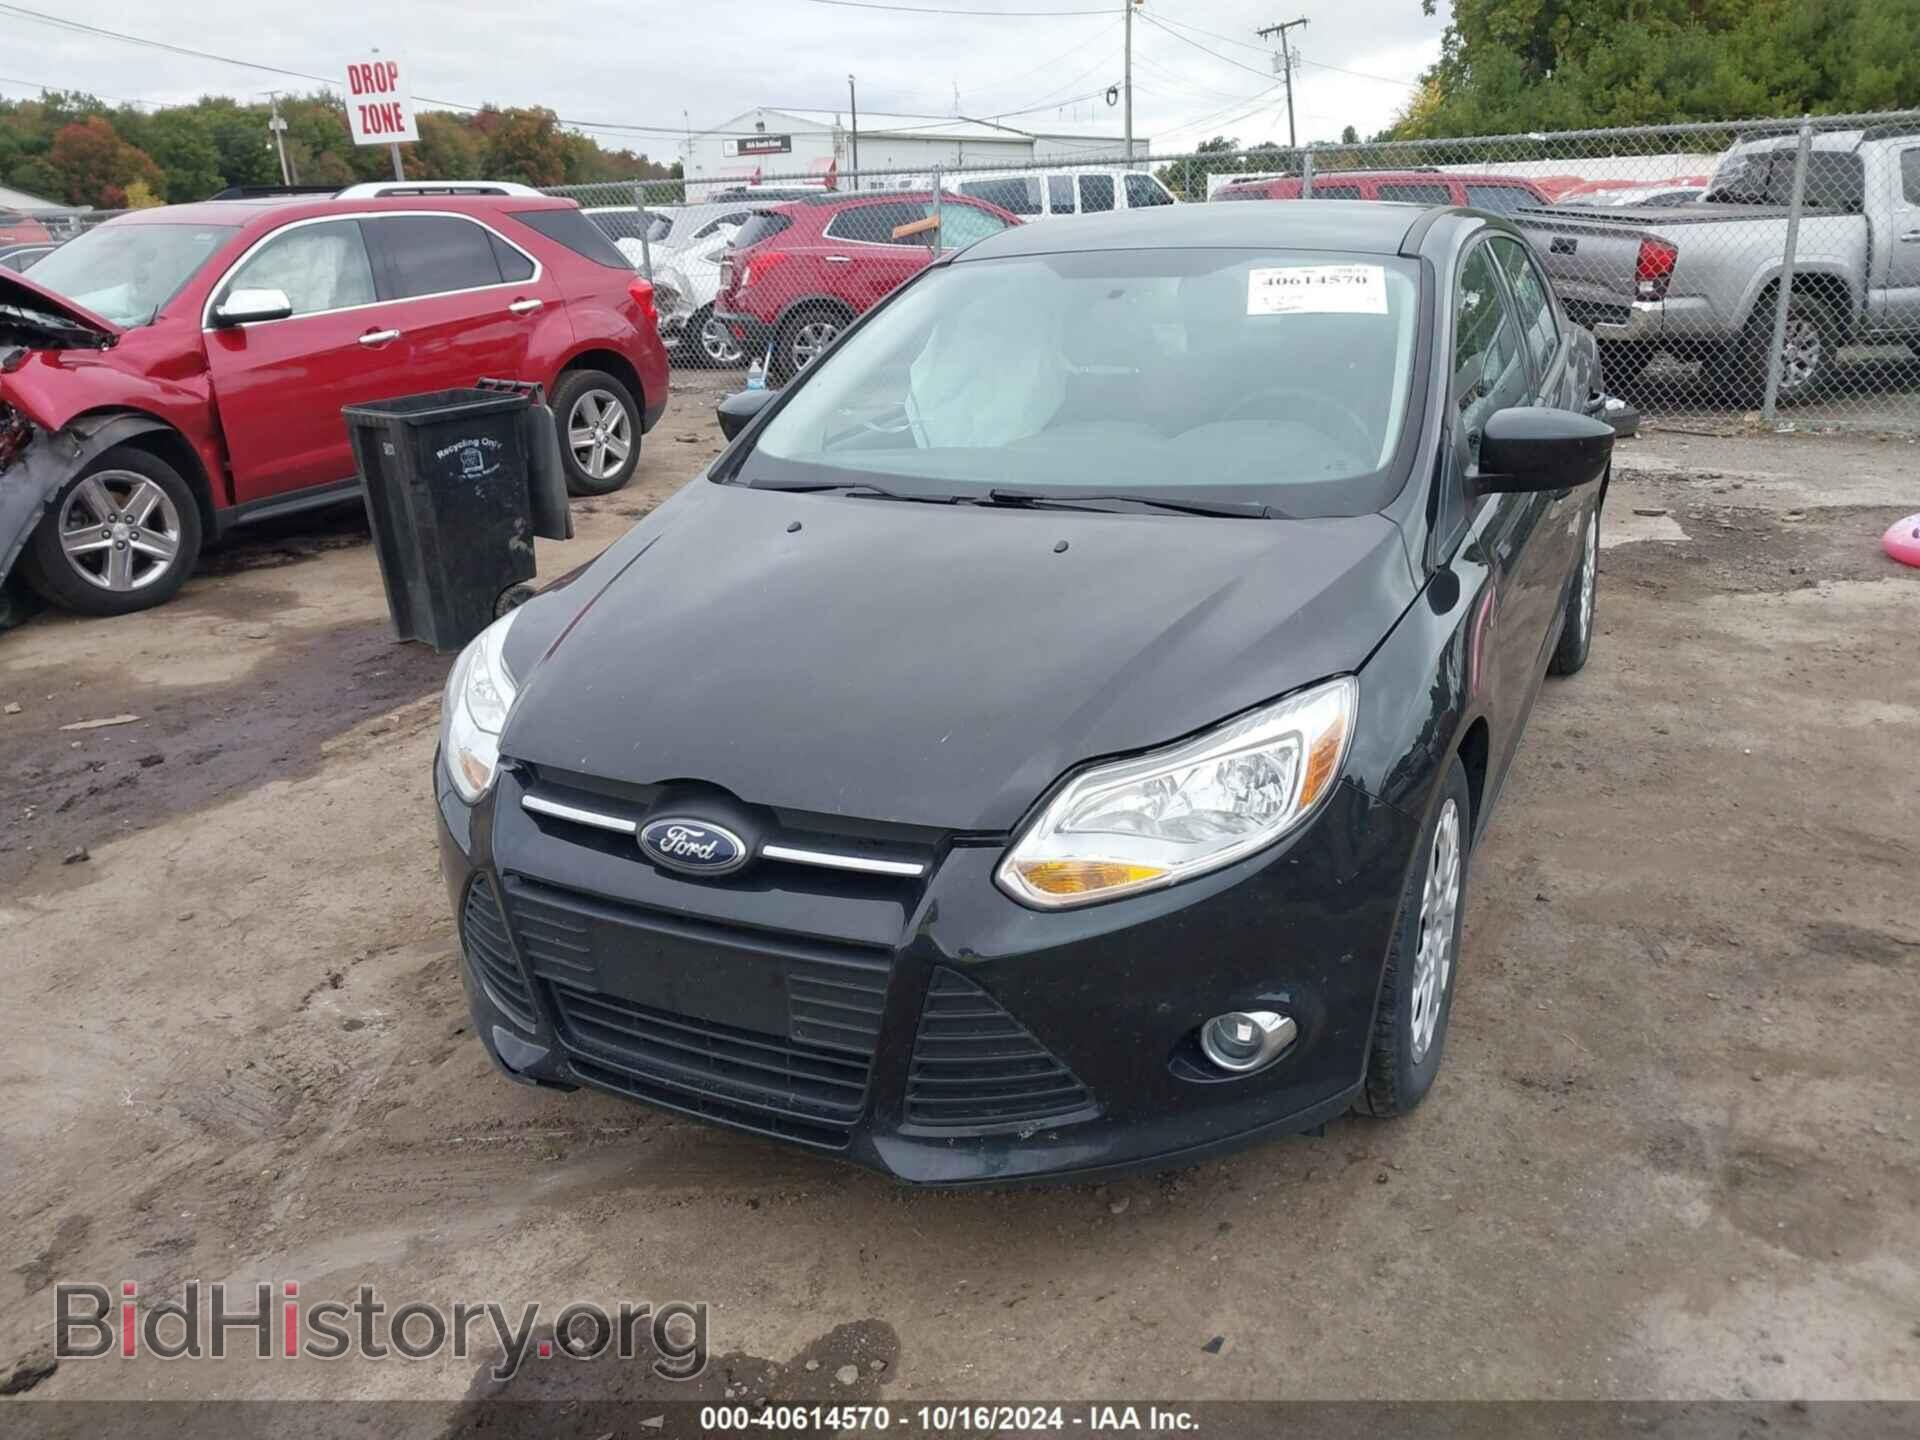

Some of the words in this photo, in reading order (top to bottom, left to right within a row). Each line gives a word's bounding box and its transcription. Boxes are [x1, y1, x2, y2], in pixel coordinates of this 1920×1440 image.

[347, 61, 398, 95] DROP
[358, 102, 405, 134] ZONE
[436, 439, 480, 459] Recycling
[660, 826, 718, 860] Ford
